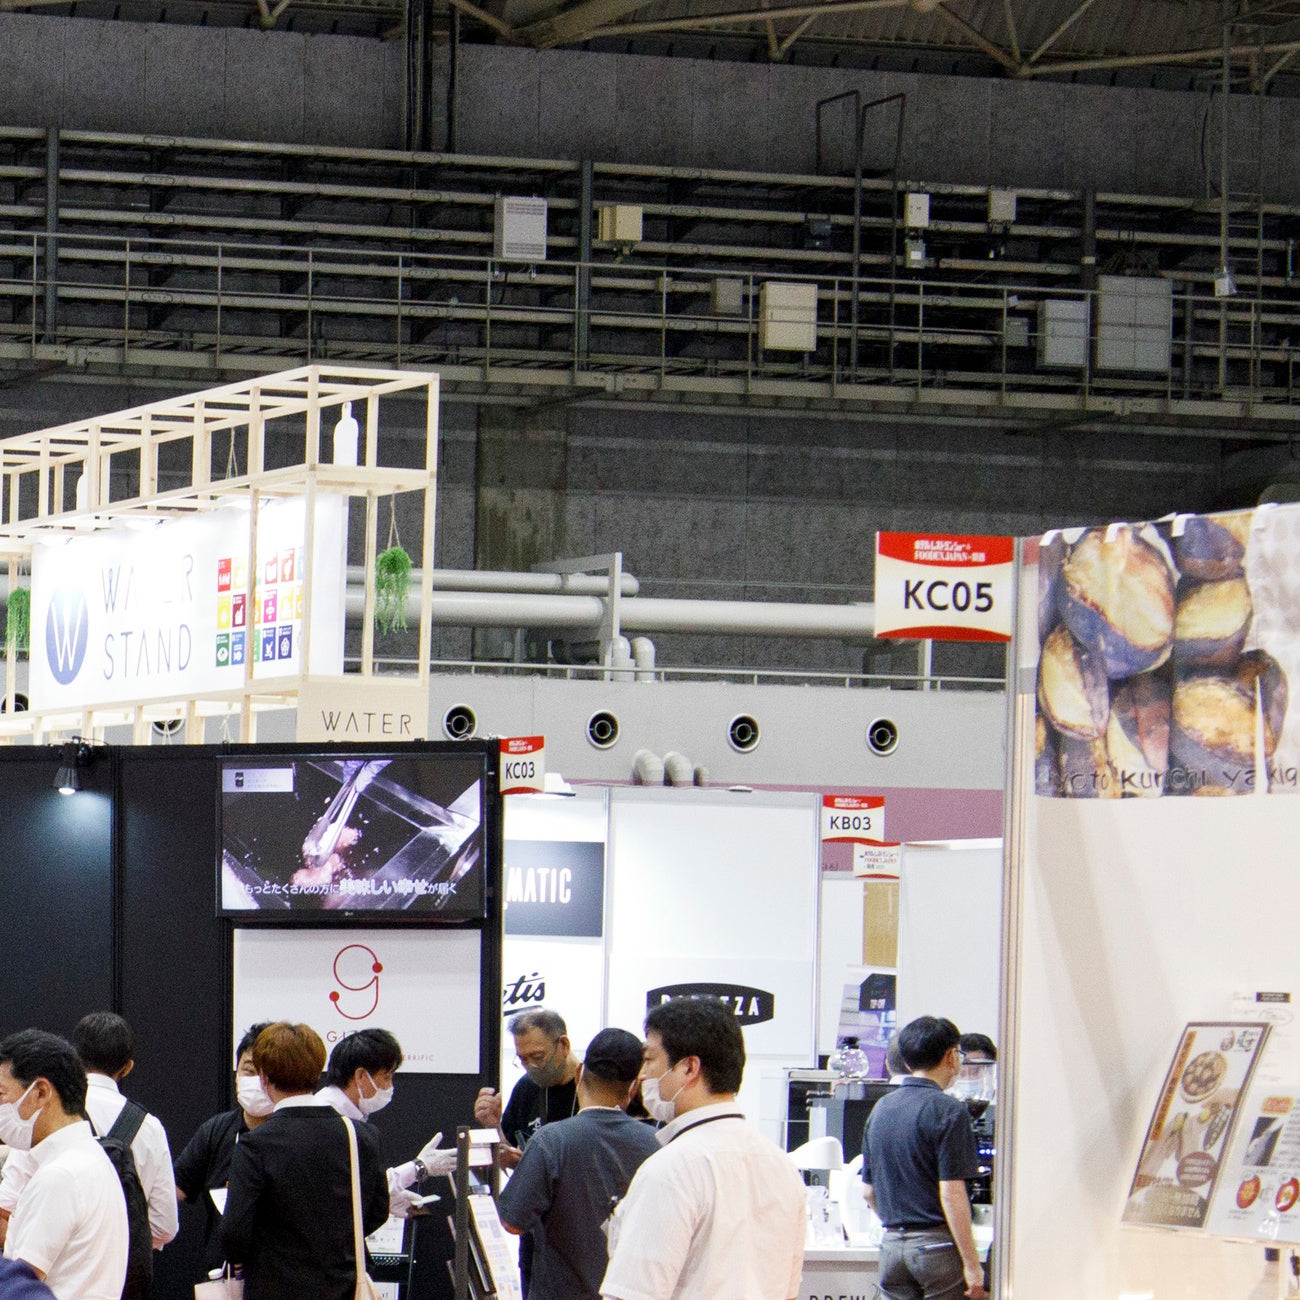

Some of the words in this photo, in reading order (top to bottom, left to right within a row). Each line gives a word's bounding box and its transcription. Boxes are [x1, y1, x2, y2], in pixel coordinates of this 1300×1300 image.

[101, 553, 194, 614] WAR
[904, 580, 993, 612] KC05
[103, 623, 192, 681] STAND
[321, 710, 412, 736] WATER
[505, 761, 535, 780] KC03
[1050, 768, 1111, 791] yoto
[830, 816, 872, 831] KB03
[503, 866, 572, 904] MATIC
[503, 972, 545, 1005] tis
